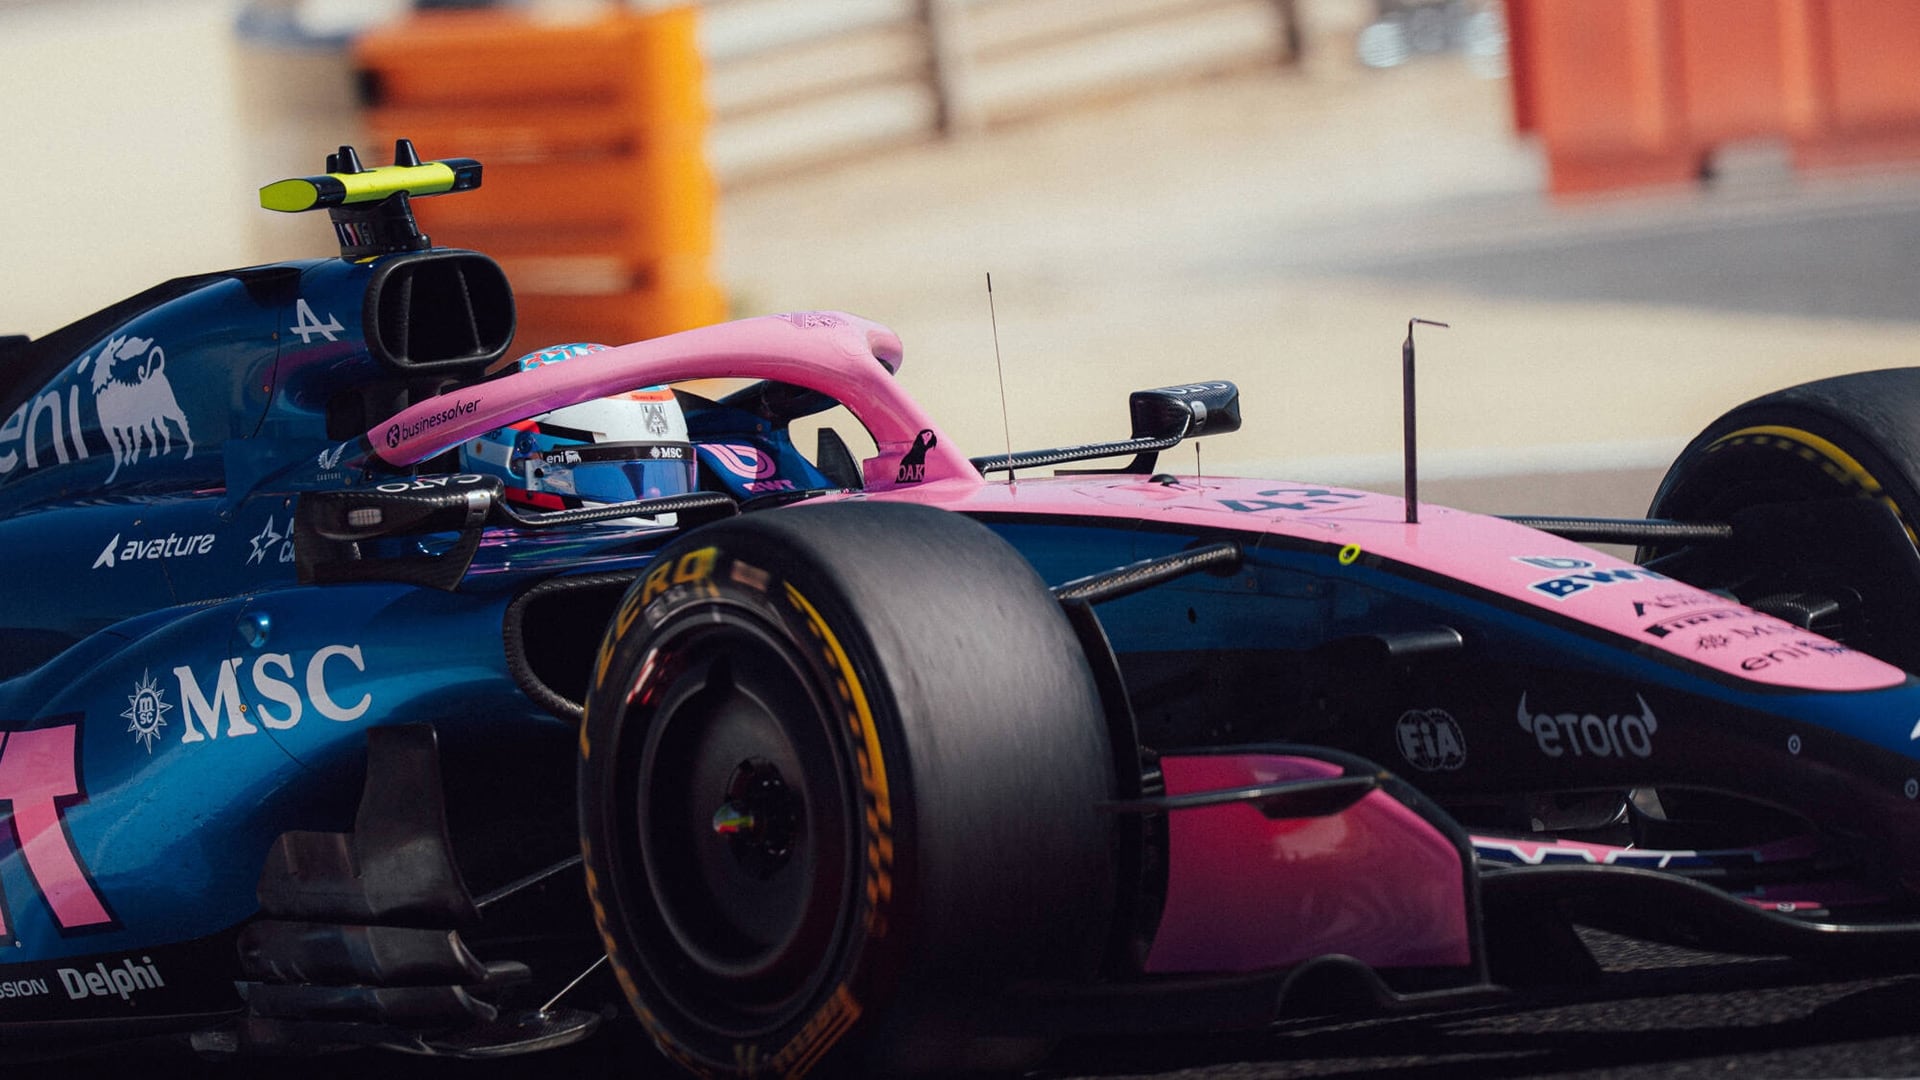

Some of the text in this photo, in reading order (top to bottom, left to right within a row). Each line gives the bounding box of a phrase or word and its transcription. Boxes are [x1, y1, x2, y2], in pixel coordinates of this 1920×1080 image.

[401, 399, 482, 440] businessolver
[546, 451, 565, 464] eni
[661, 447, 683, 459] MSC
[897, 464, 925, 482] OAK
[120, 531, 215, 562] avature
[173, 644, 372, 744] MSC
[57, 956, 165, 1000] Delphi
